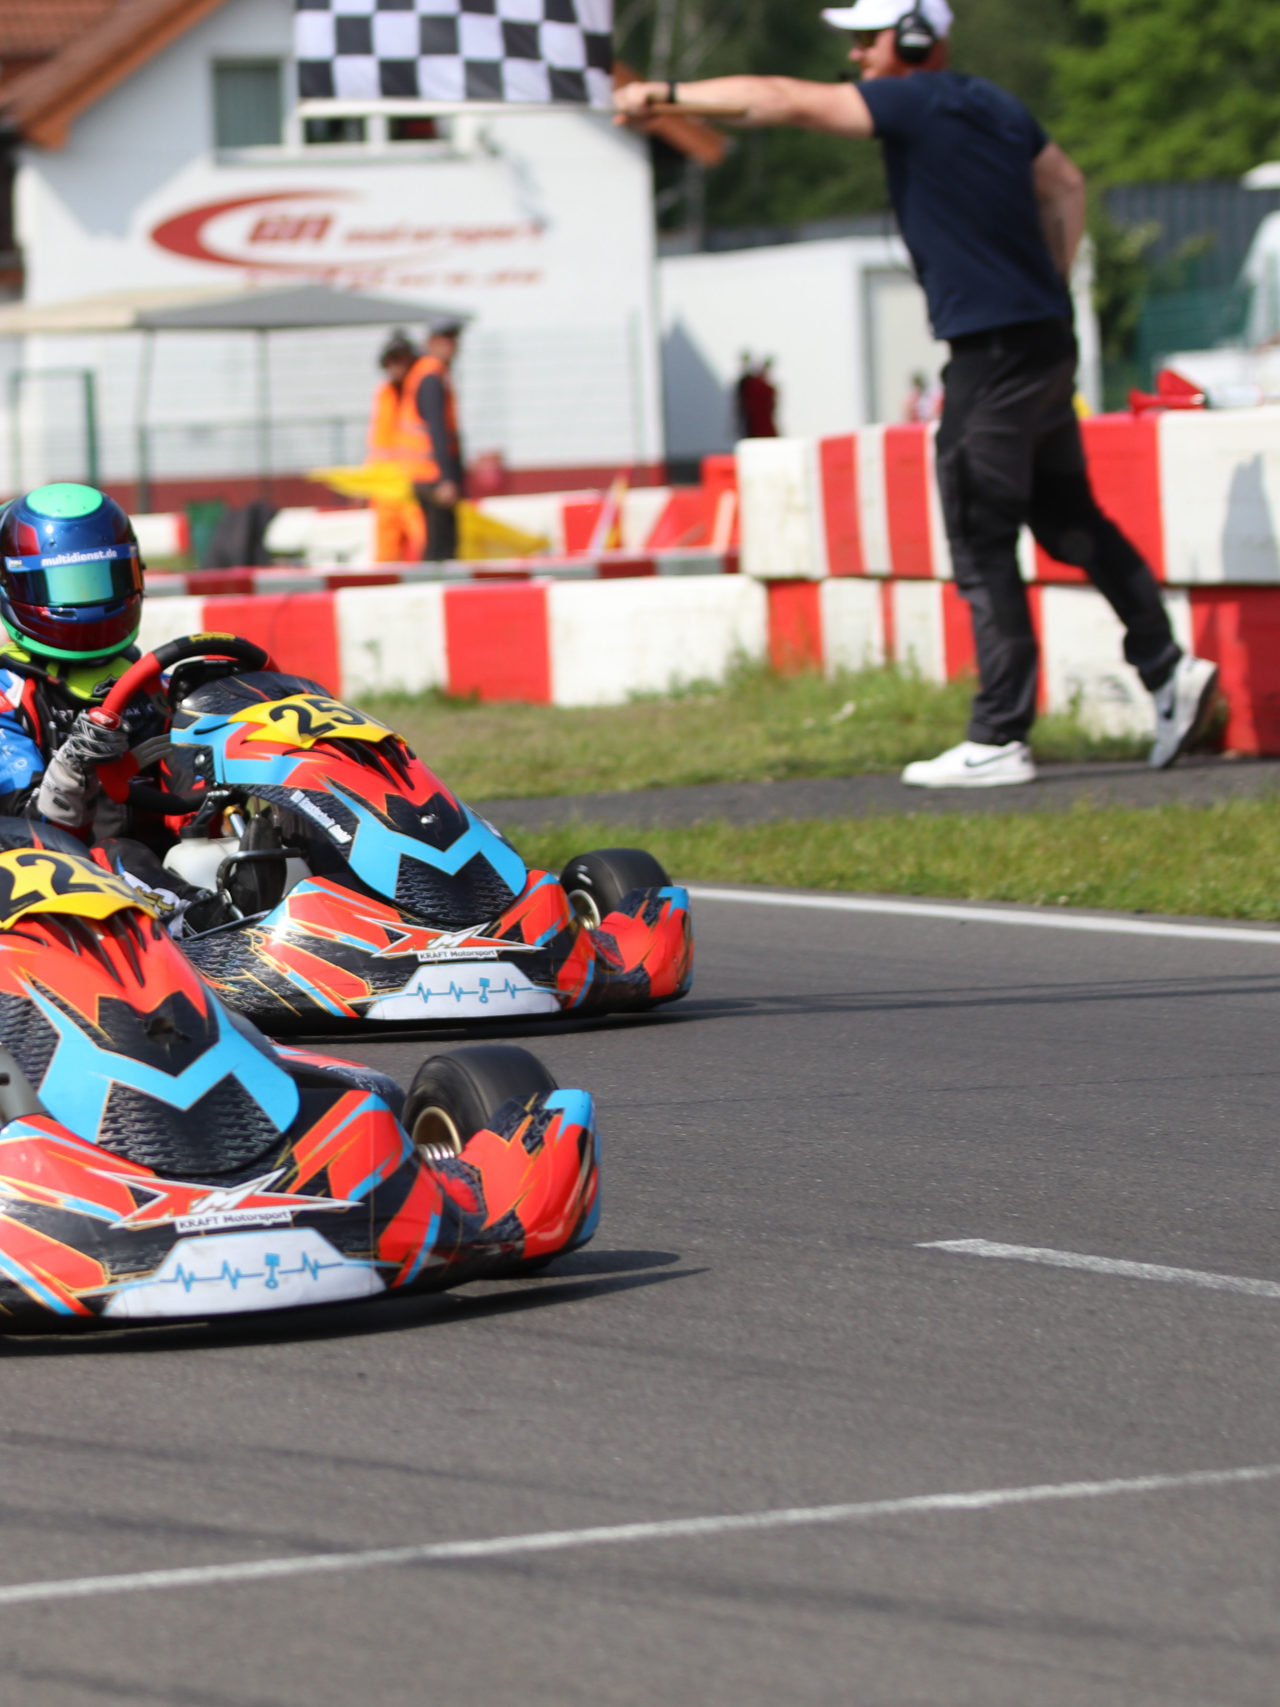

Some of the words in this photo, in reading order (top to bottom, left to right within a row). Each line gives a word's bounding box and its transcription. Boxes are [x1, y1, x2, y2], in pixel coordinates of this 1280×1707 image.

[41, 547, 118, 568] multidienst.de
[420, 949, 448, 960] KRAFT
[450, 948, 496, 959] Motorsport
[180, 1215, 219, 1229] KRAFT
[223, 1210, 290, 1225] Motorsport
